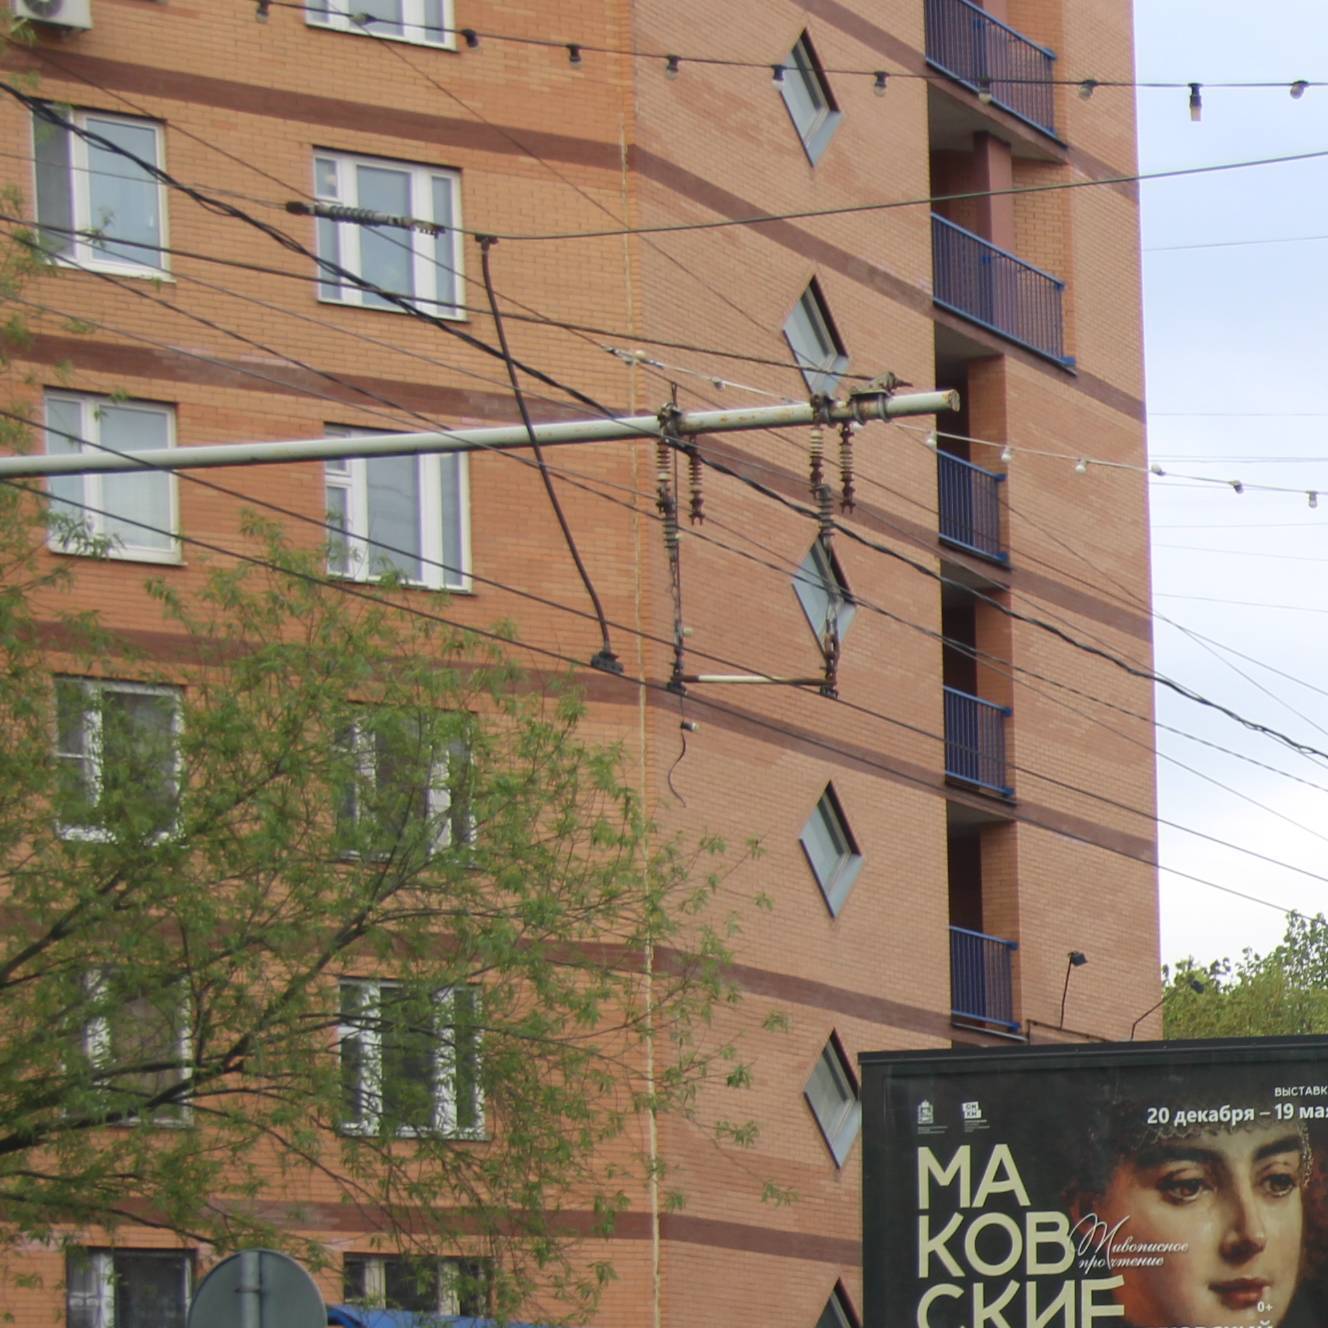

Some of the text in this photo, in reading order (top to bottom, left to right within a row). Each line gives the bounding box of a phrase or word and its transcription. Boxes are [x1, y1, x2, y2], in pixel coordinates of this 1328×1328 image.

[1147, 1107, 1170, 1124] 20
[1173, 1105, 1255, 1126] декабря
[1274, 1103, 1294, 1120] 19
[917, 1143, 1031, 1209] МА
[918, 1211, 1076, 1279] КОВ
[1257, 1301, 1273, 1313] 0+
